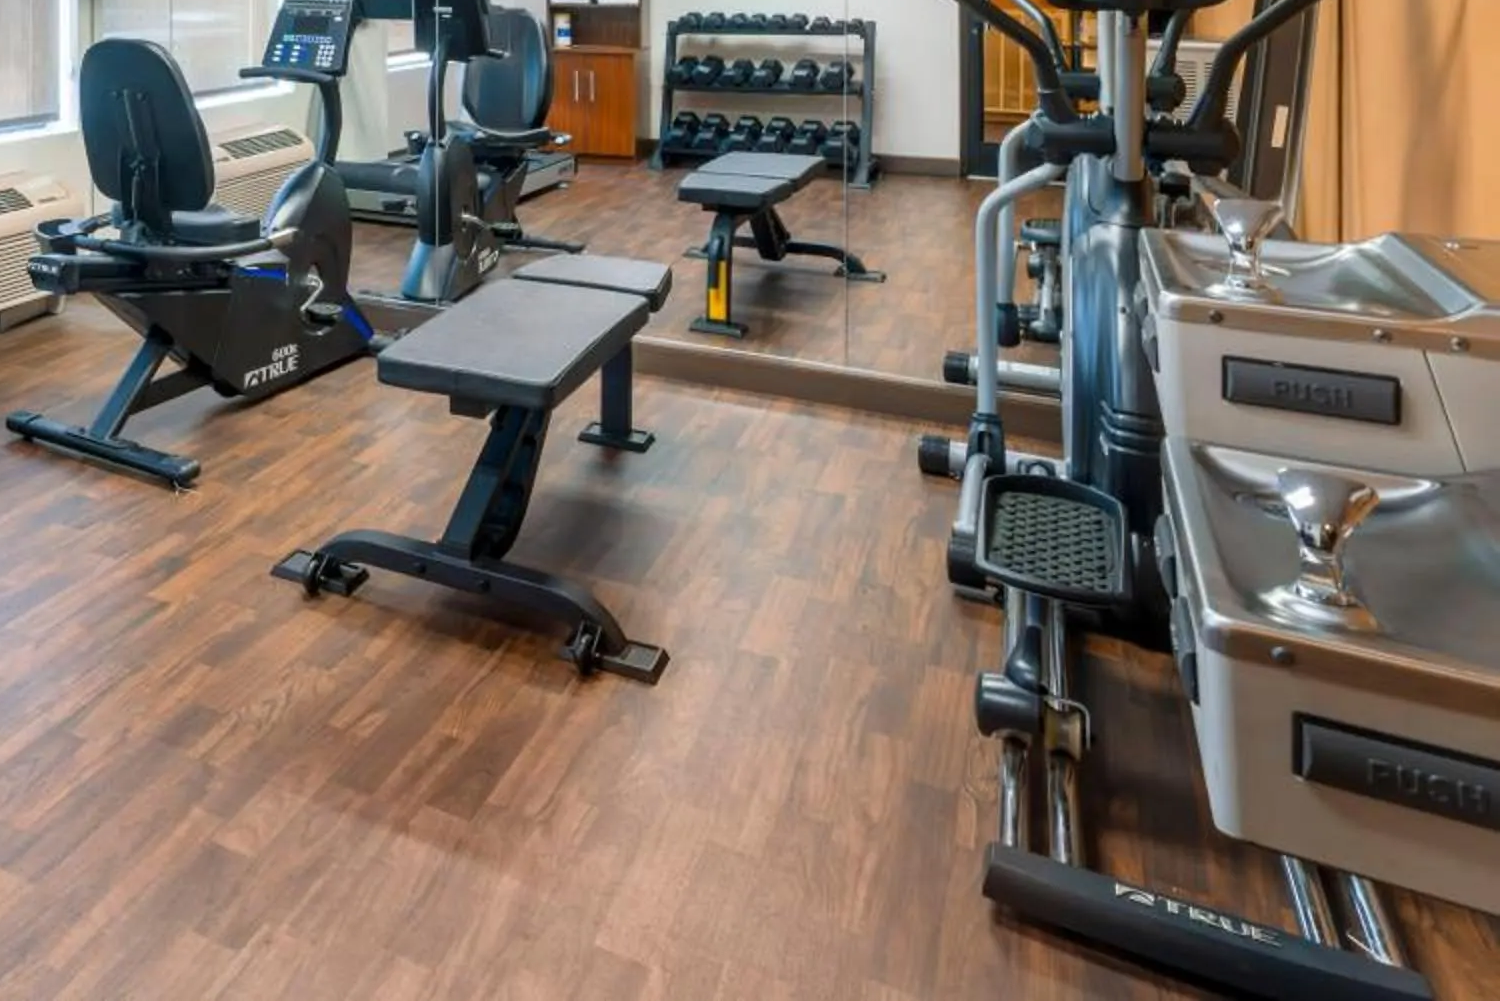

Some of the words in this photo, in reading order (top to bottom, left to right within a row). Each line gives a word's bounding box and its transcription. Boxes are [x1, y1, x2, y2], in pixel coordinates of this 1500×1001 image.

[260, 354, 299, 383] TRUE
[1274, 380, 1353, 410] PUSH
[1366, 756, 1493, 816] PUSH
[1157, 895, 1283, 948] TRUE
